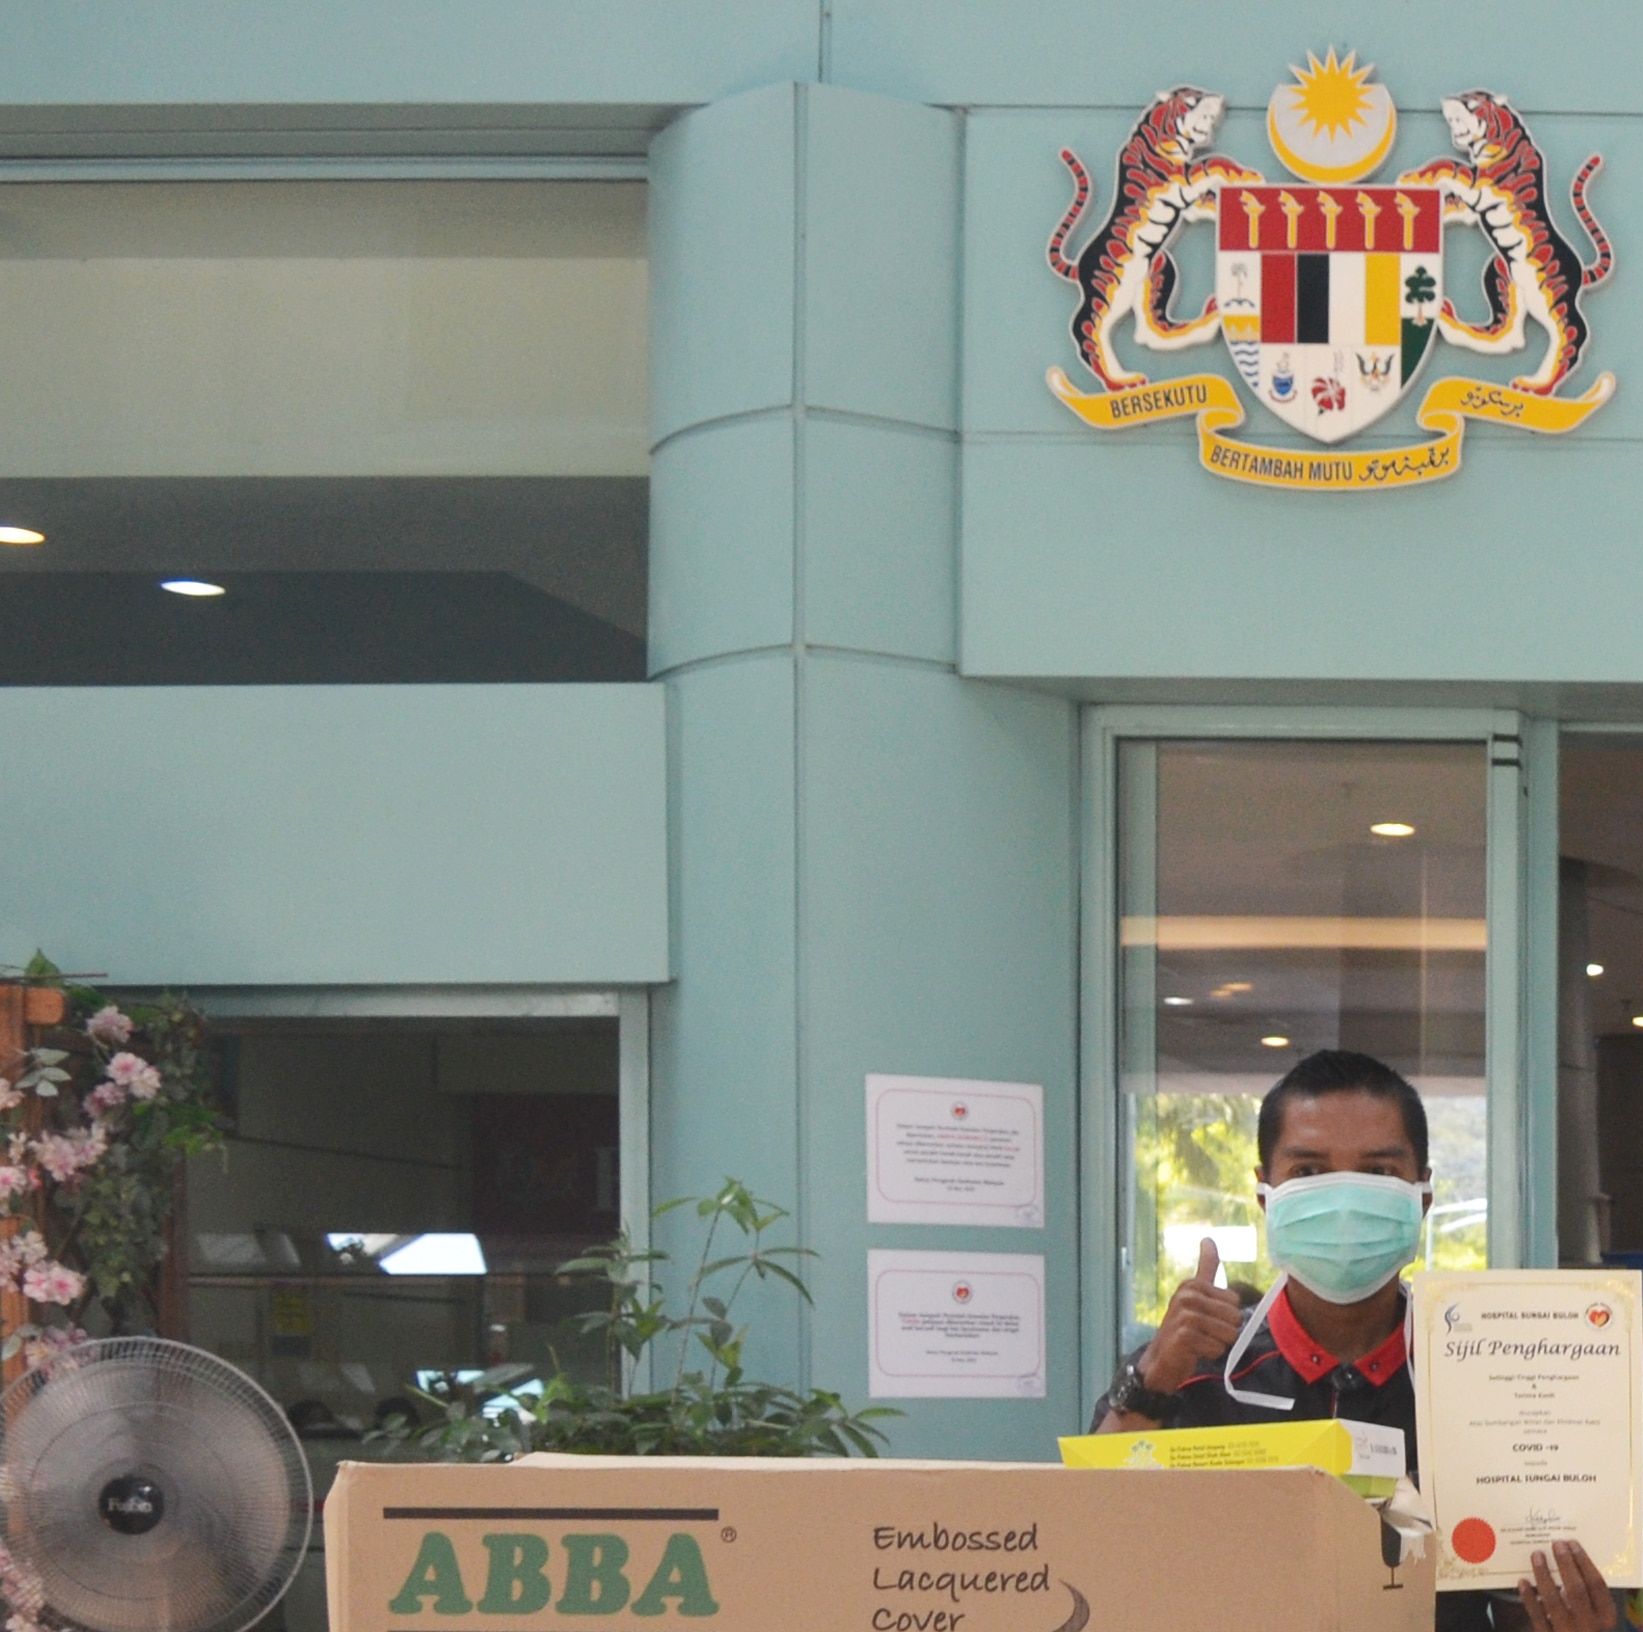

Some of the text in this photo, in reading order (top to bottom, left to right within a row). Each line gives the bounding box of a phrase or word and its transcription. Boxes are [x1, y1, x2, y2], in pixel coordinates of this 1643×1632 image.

[1109, 384, 1208, 419] BERSEKUTU
[1209, 444, 1353, 481] BERTAMBAH MUTU
[1444, 1338, 1621, 1363] Sijil Penghargaan
[872, 1522, 1039, 1554] Embossed
[388, 1530, 720, 1618] ABBA
[872, 1565, 1051, 1602] Lacquered
